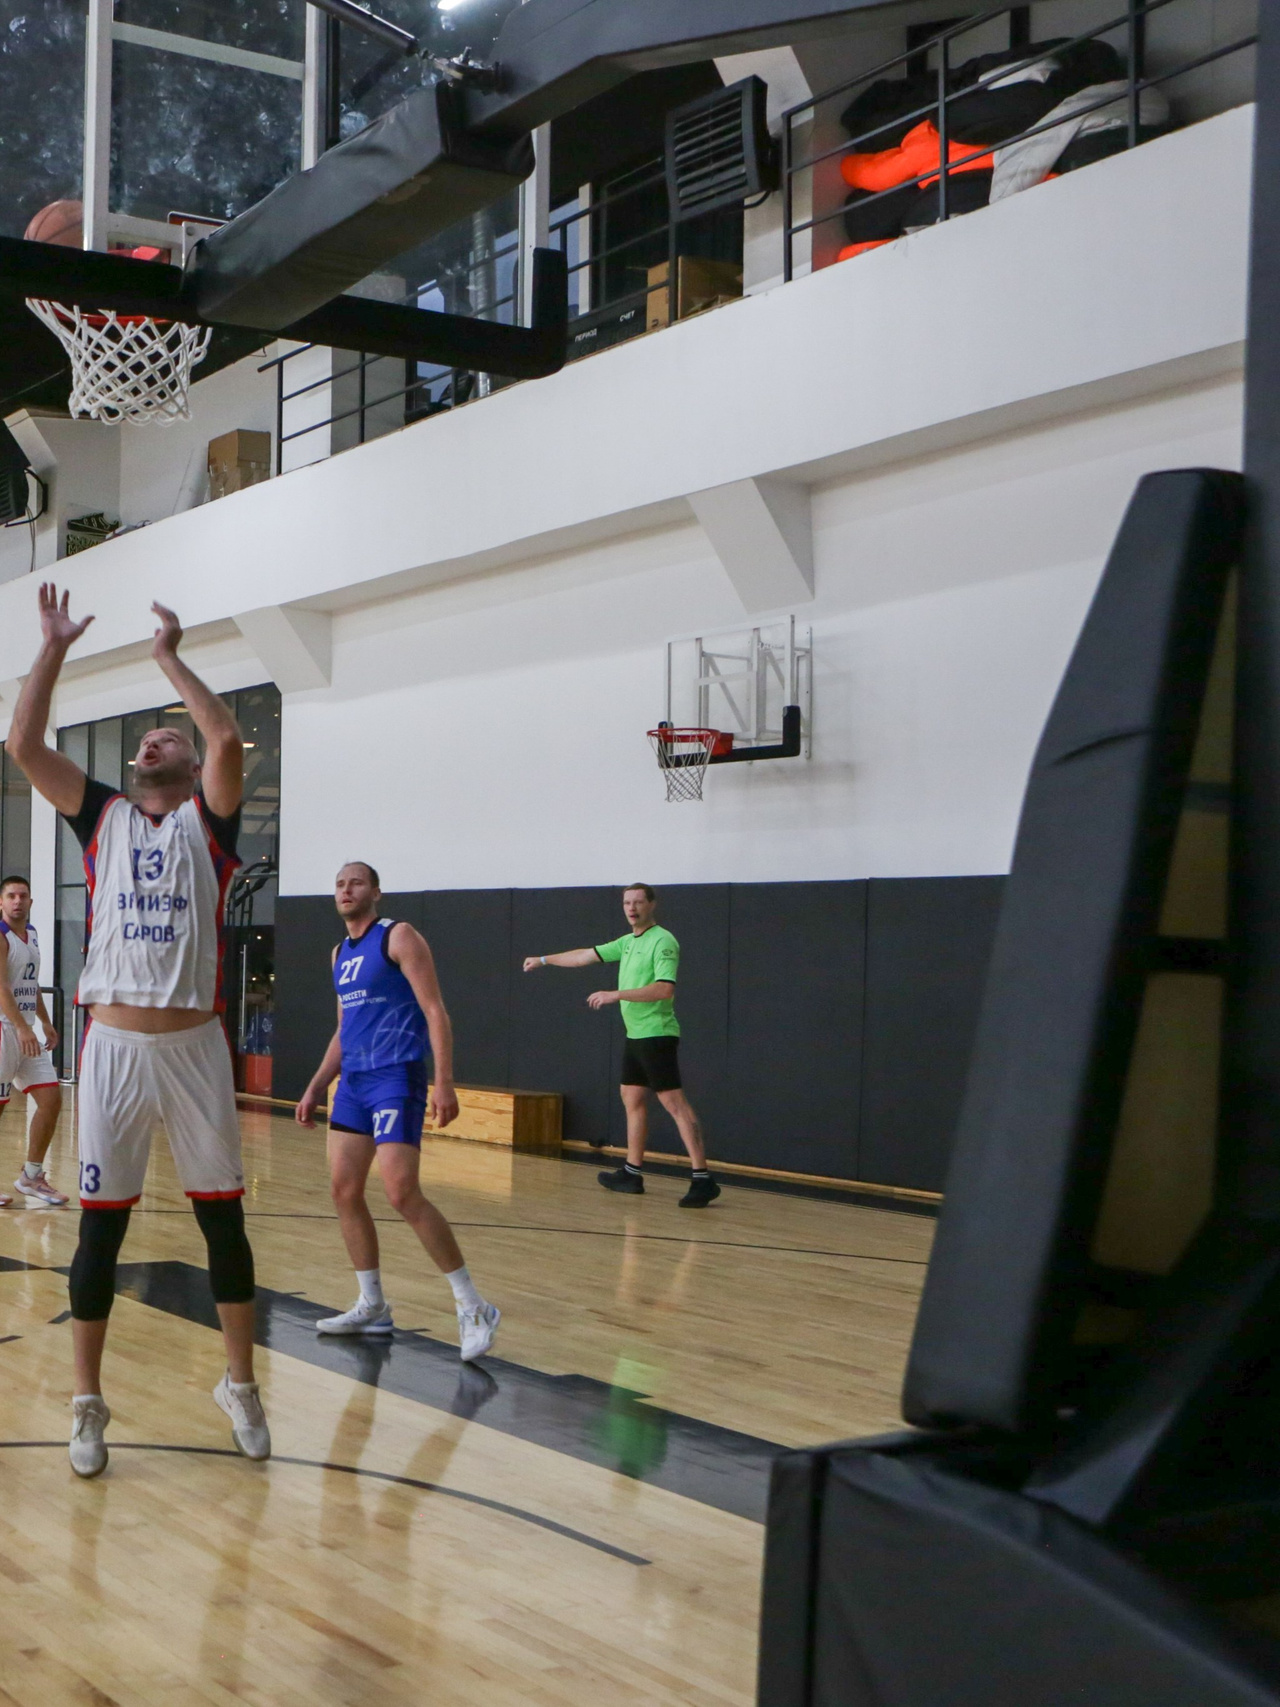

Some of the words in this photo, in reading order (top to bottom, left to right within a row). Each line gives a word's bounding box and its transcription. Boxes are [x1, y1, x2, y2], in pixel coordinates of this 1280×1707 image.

[132, 847, 164, 881] 13
[123, 922, 176, 943] САРОВ
[22, 962, 36, 980] 12
[339, 956, 364, 985] 27
[373, 1109, 398, 1138] 27
